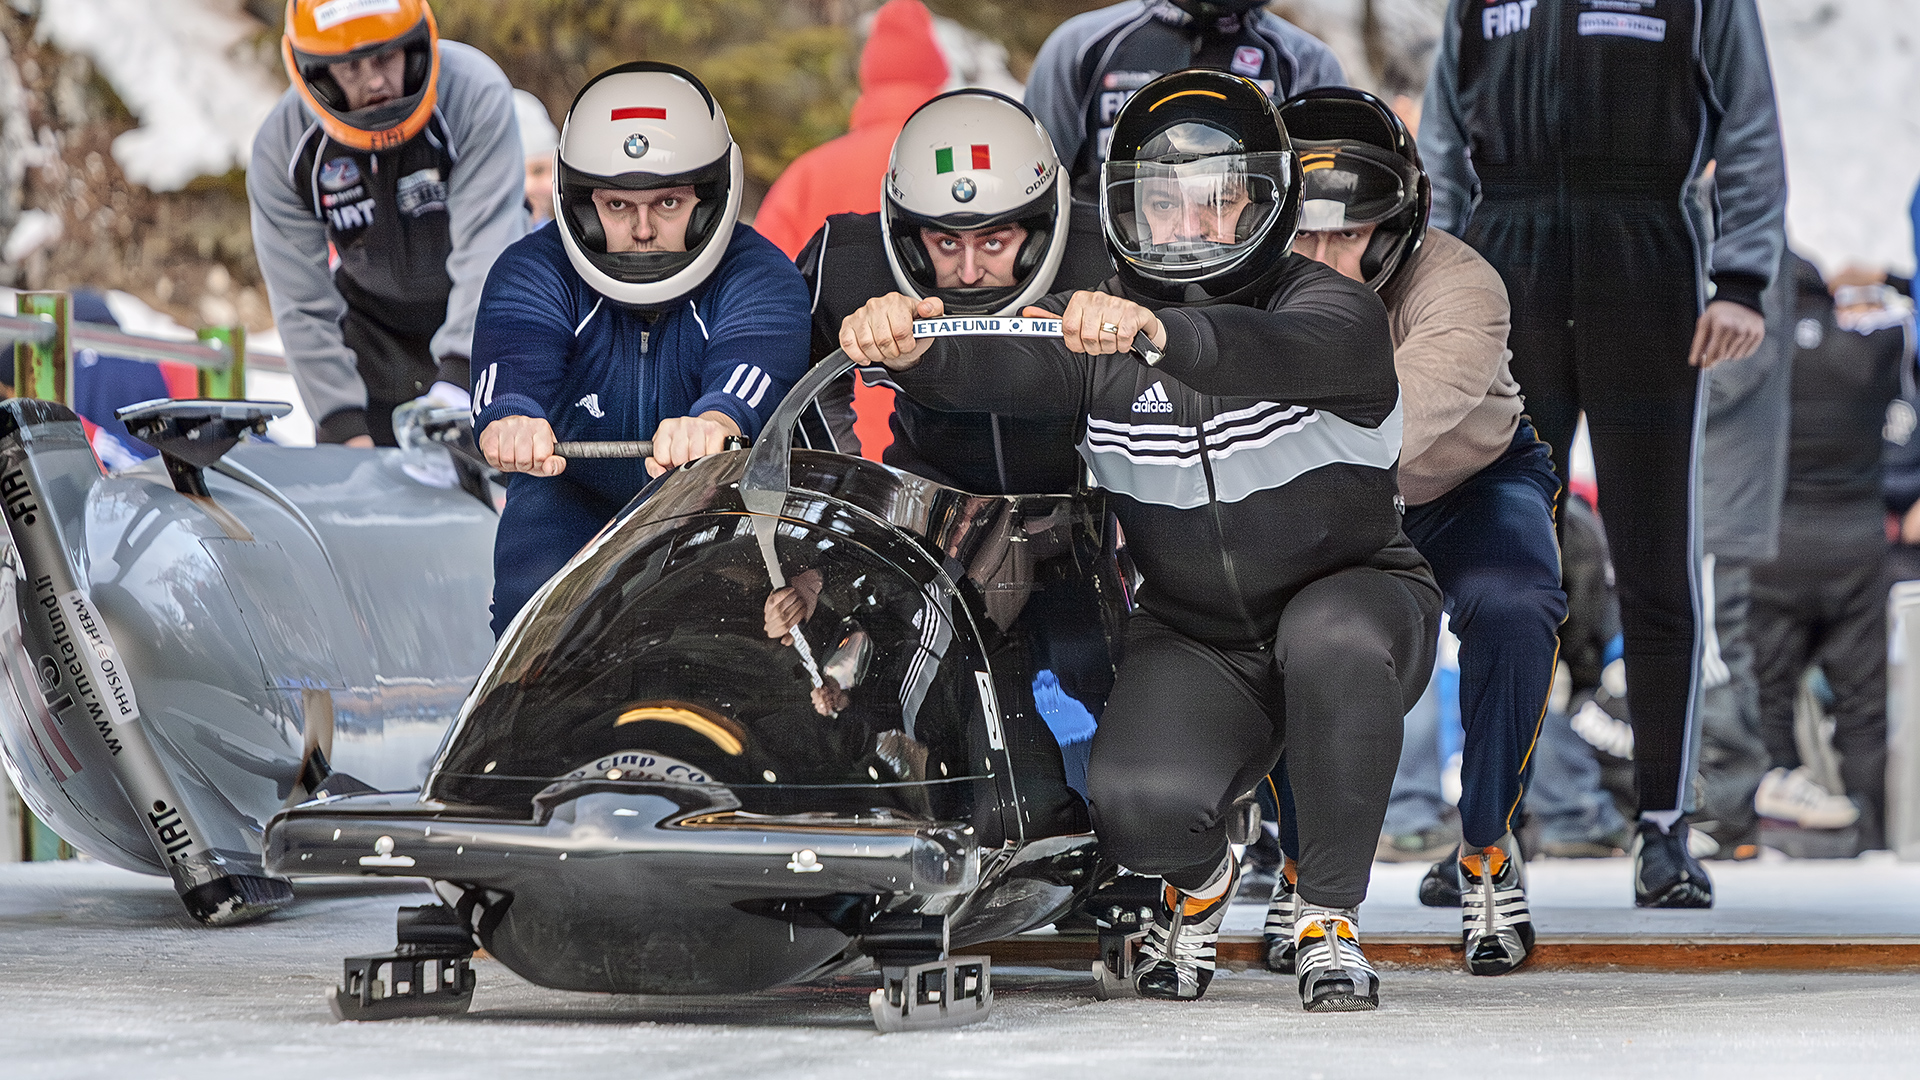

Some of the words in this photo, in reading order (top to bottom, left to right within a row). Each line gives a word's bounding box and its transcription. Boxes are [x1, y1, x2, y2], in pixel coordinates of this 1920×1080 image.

[1483, 0, 1538, 40] FIAT
[1131, 400, 1173, 413] adidas
[0, 469, 38, 521] FIA
[35, 574, 123, 756] www.metafund.li
